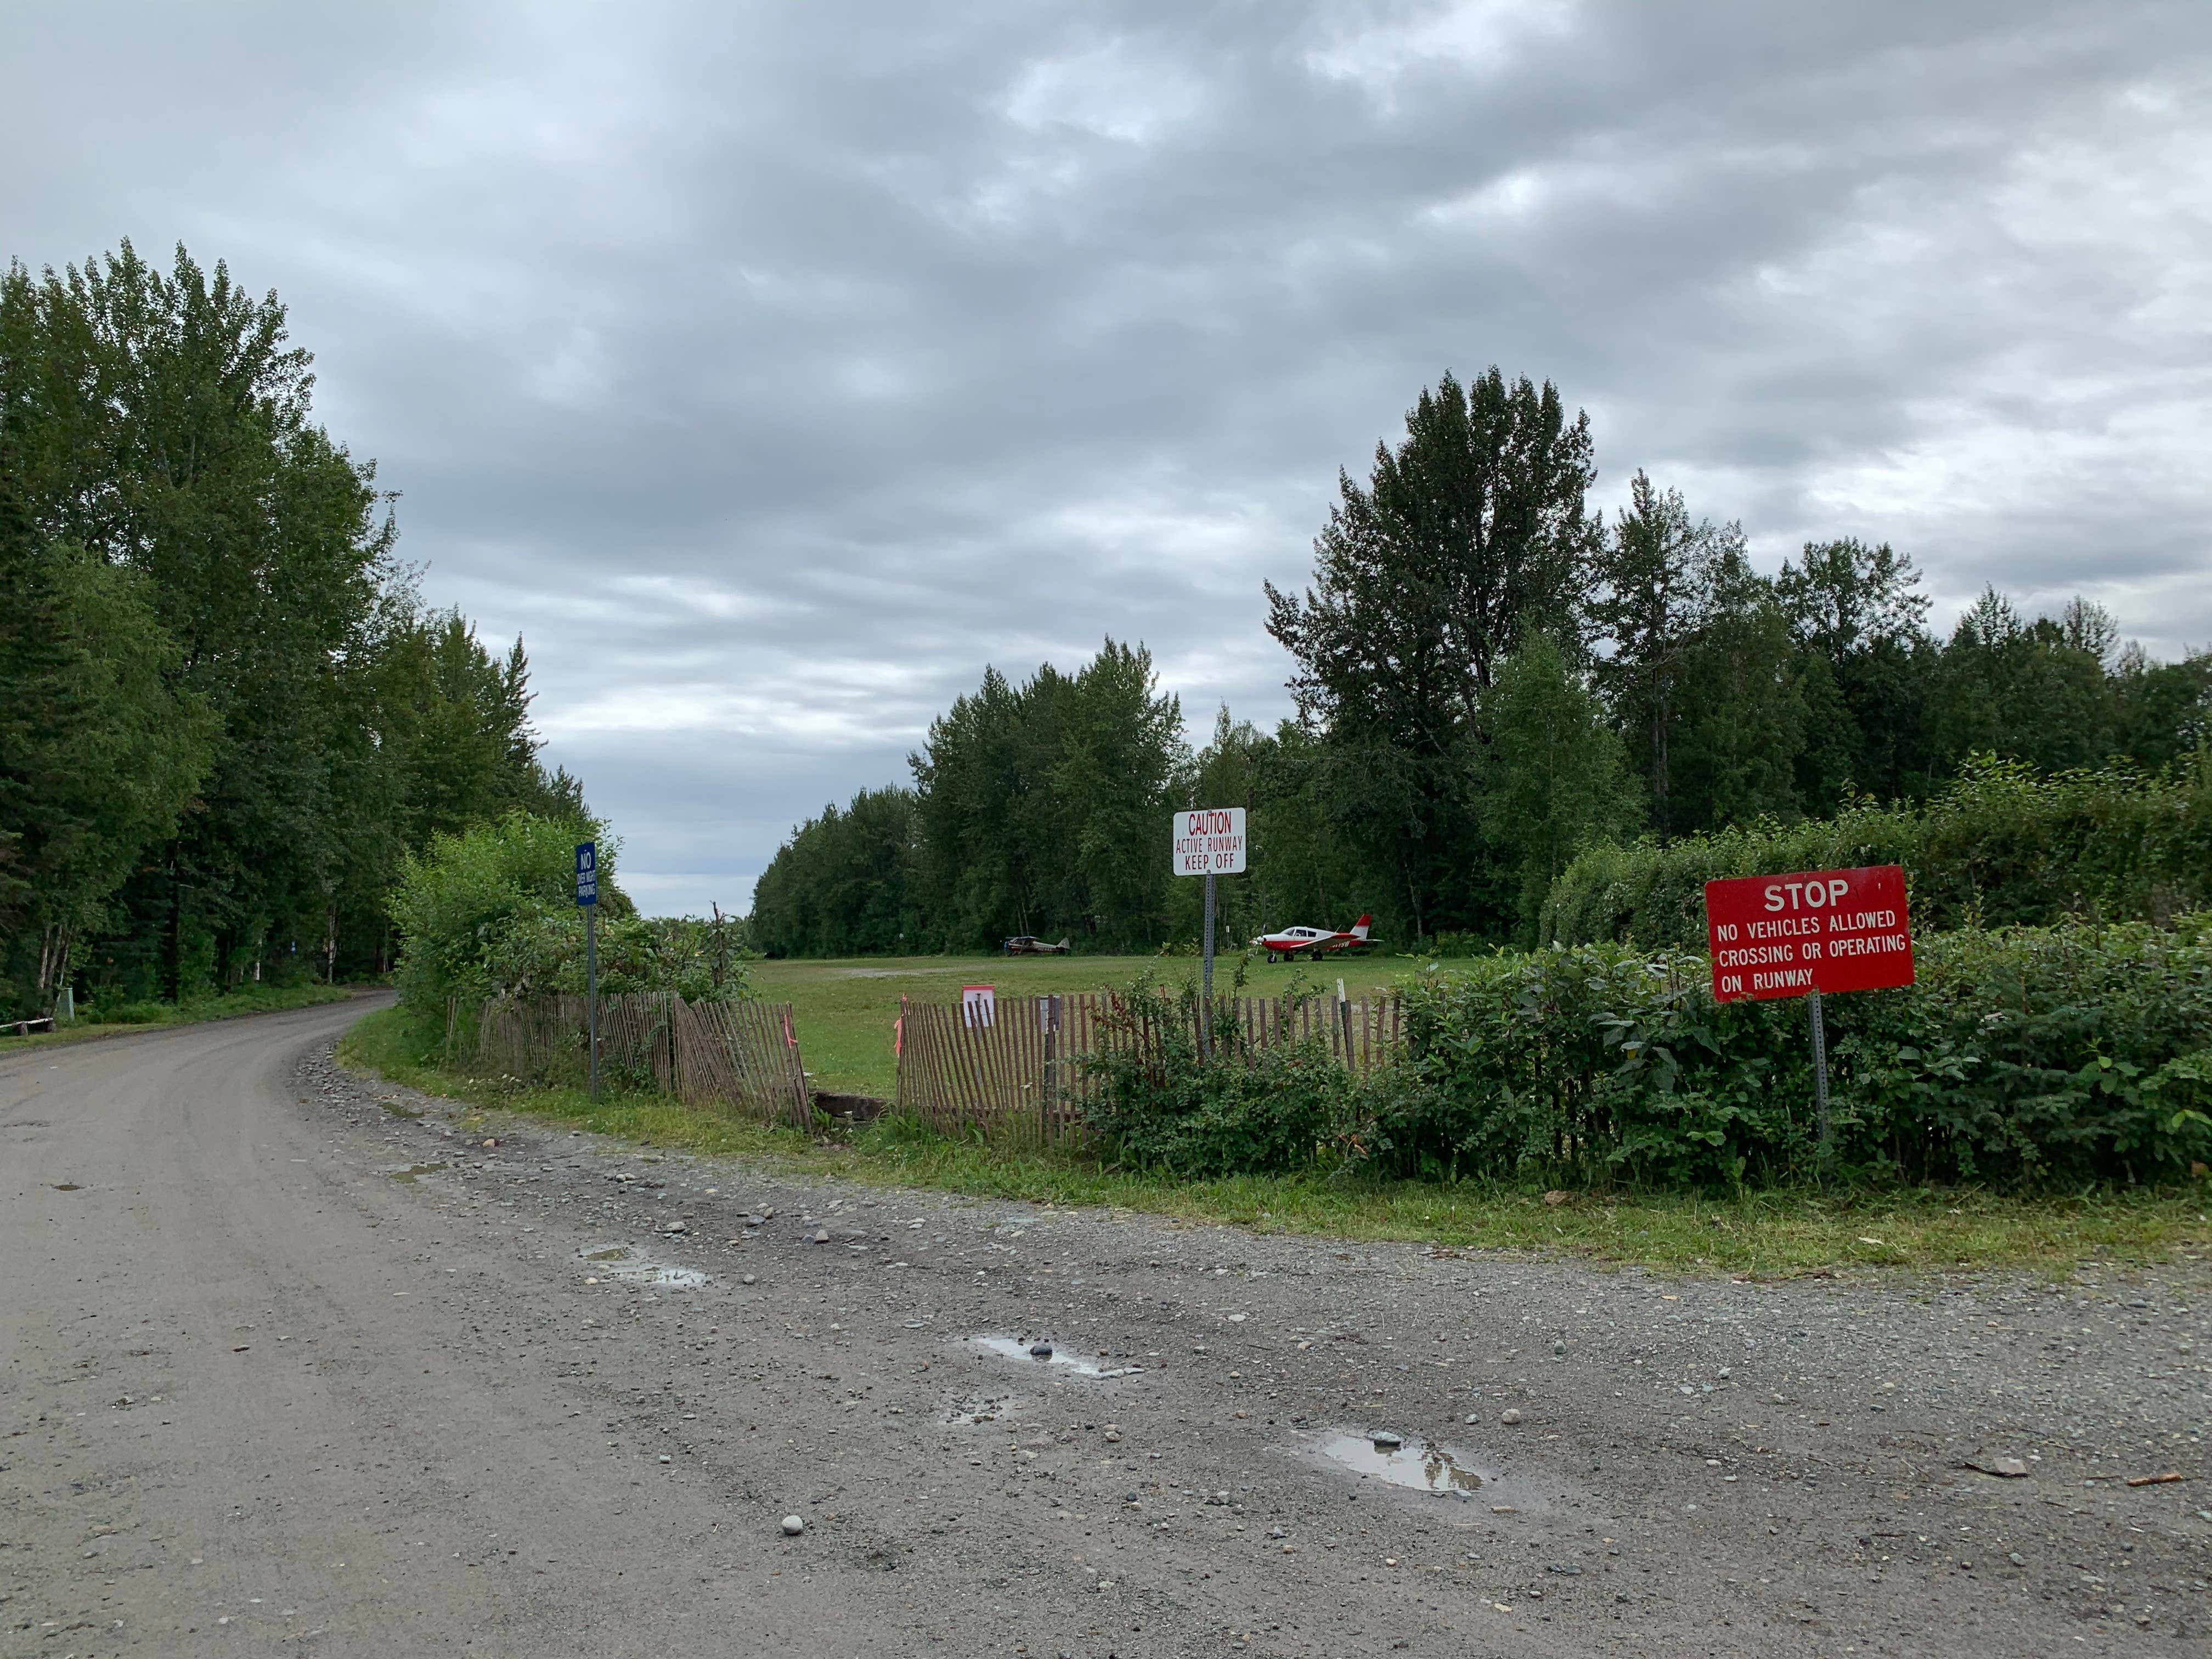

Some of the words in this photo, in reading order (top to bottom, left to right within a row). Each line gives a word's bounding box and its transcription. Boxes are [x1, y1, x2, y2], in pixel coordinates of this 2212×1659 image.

[1189, 811, 1231, 836] CAUTION
[1176, 838, 1203, 854] ACTIVE
[1207, 836, 1243, 852] RUNWAY
[580, 851, 591, 870] NO
[1186, 855, 1209, 870] KEEP
[1216, 853, 1234, 868] OFF
[1764, 879, 1848, 912] STOP
[1717, 923, 1738, 941] NO
[1747, 917, 1820, 939] VEHICLES
[1829, 910, 1895, 932] ALLOWED
[1719, 945, 1793, 967] CROSSING
[1802, 943, 1822, 960] OR
[1829, 934, 1906, 957] OPERATING
[1722, 975, 1742, 992] ON
[1753, 968, 1813, 990] RUNWAY
